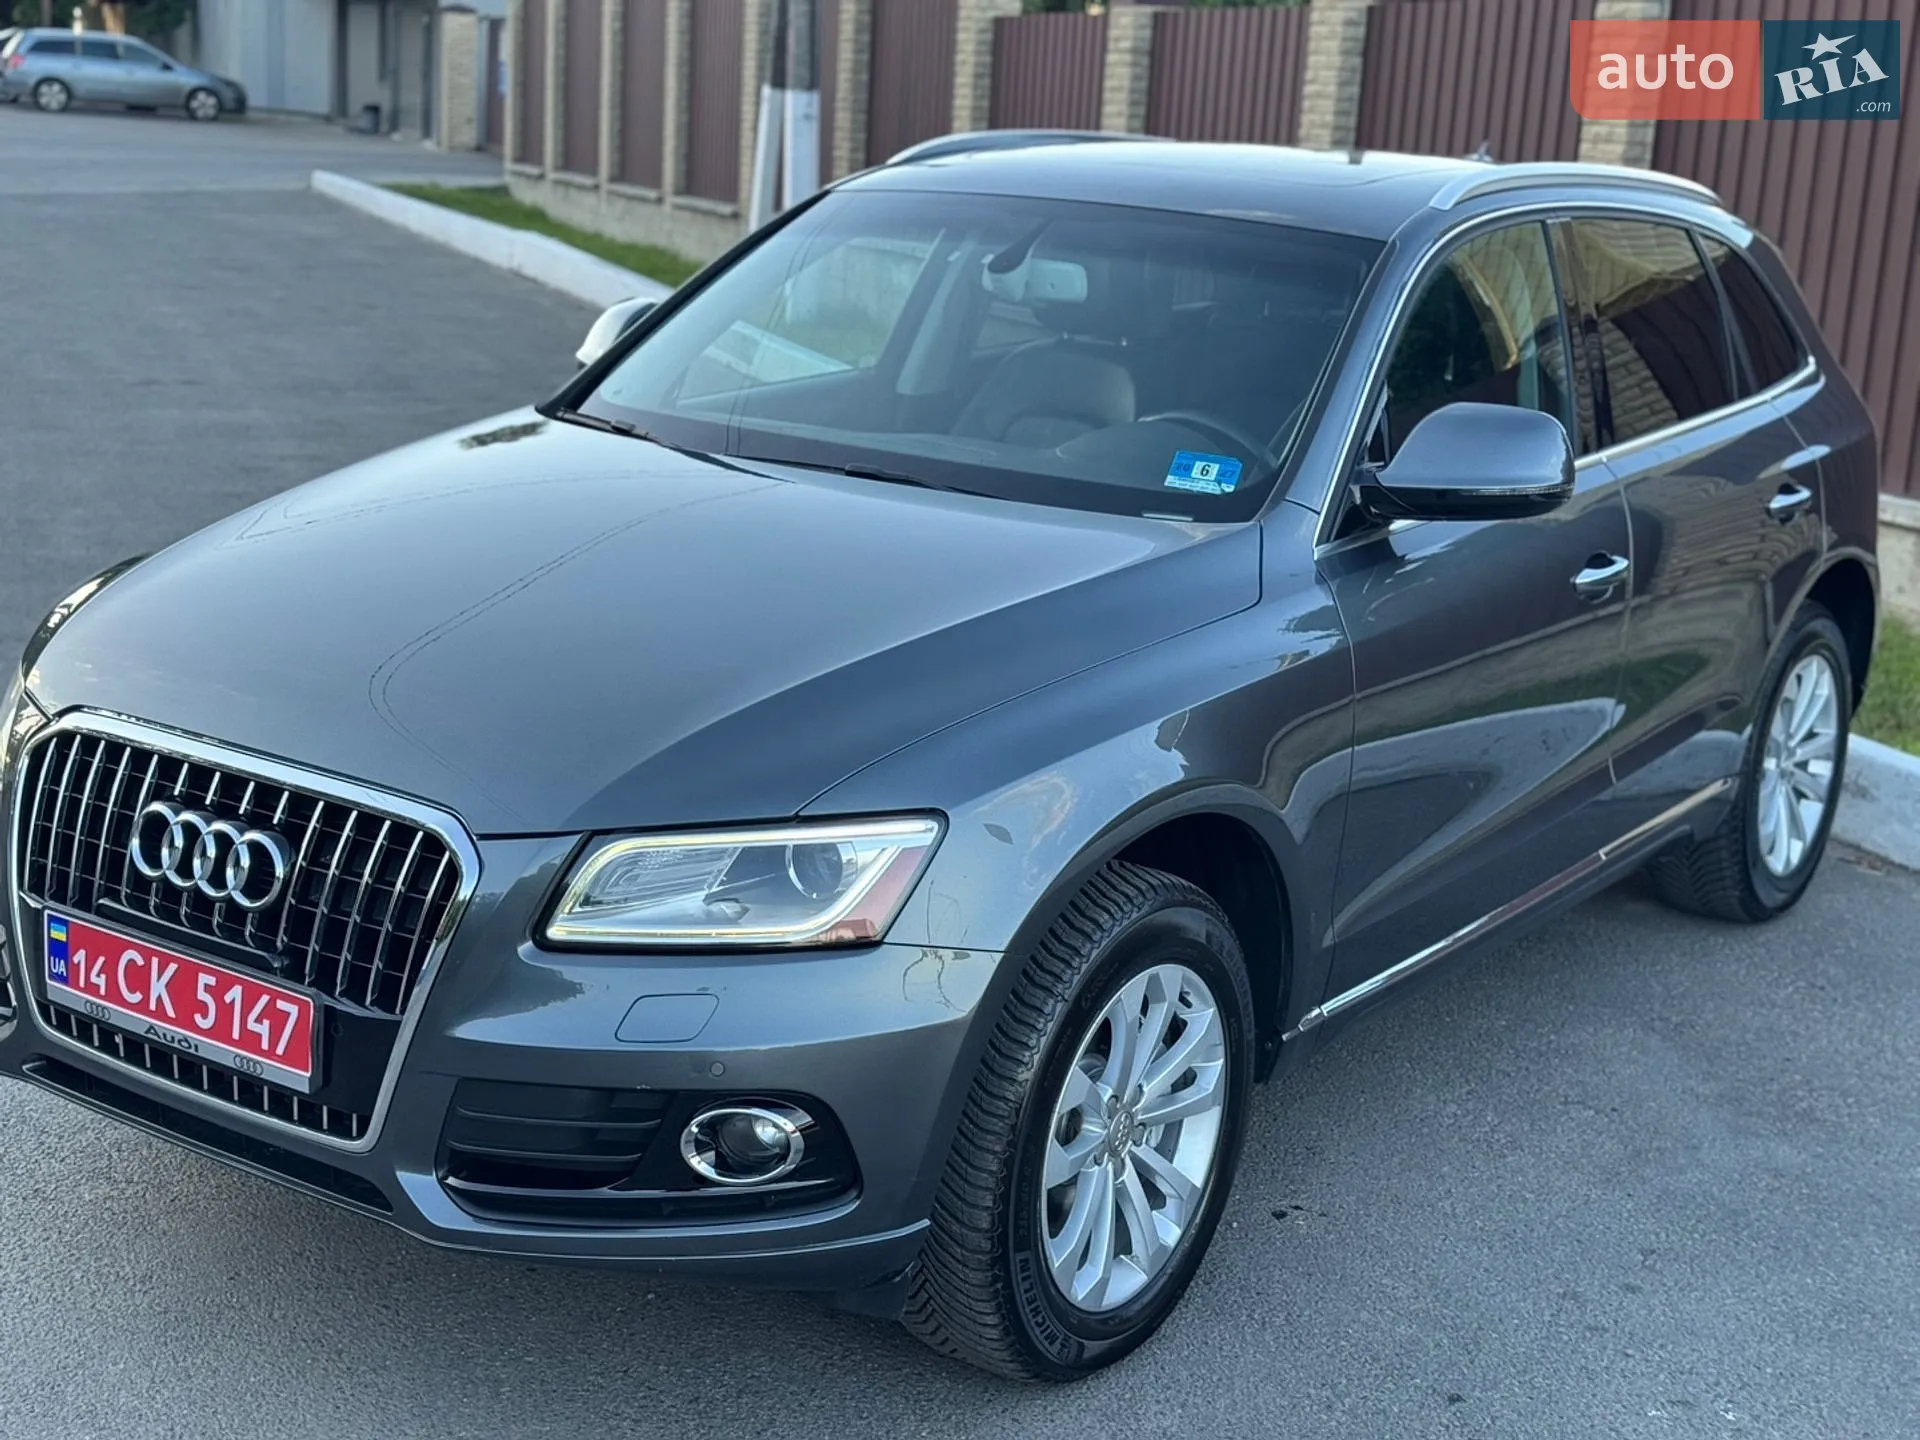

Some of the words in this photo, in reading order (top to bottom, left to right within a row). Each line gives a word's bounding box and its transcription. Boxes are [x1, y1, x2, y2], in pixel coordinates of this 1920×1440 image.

[1201, 464, 1211, 477] 6
[49, 955, 67, 977] UA
[193, 973, 299, 1055] 5147
[144, 1024, 199, 1053] Audi
[1018, 1256, 1062, 1346] MICHELIN
